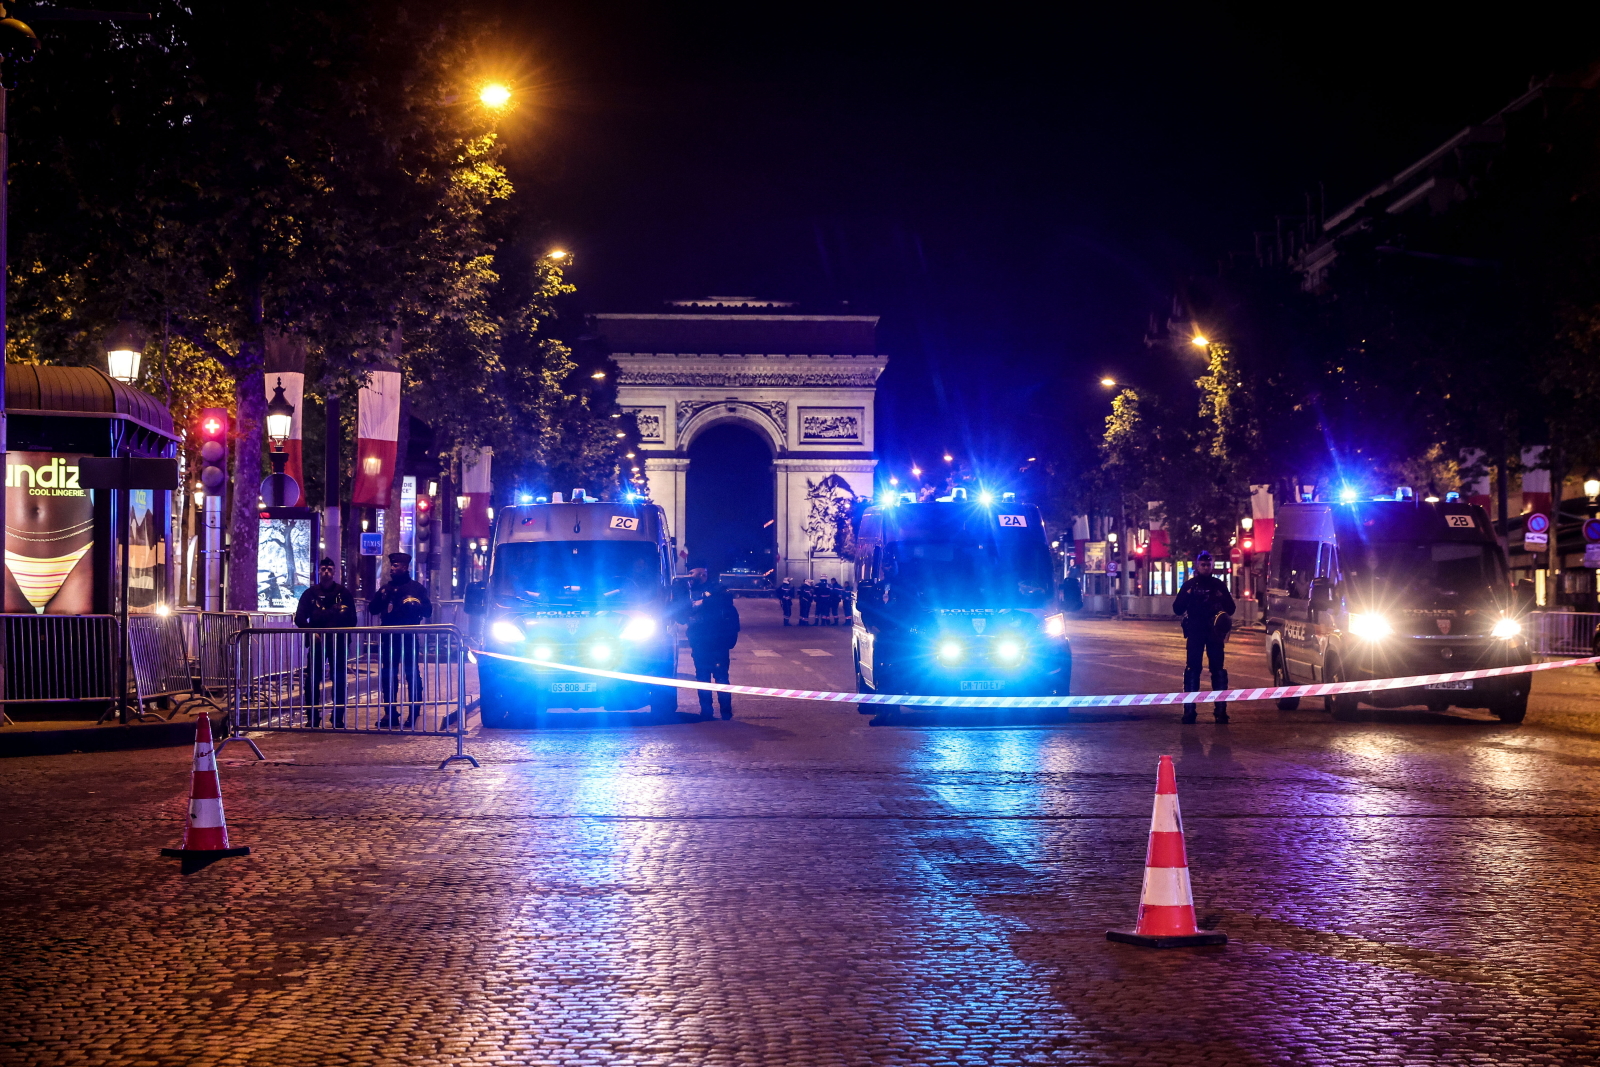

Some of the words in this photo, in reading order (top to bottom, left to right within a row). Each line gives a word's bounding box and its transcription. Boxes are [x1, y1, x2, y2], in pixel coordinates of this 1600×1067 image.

[52, 489, 86, 497] LINGERIE.
[615, 517, 633, 528] 2C
[1003, 516, 1021, 526] 2A
[1450, 516, 1469, 526] 2B
